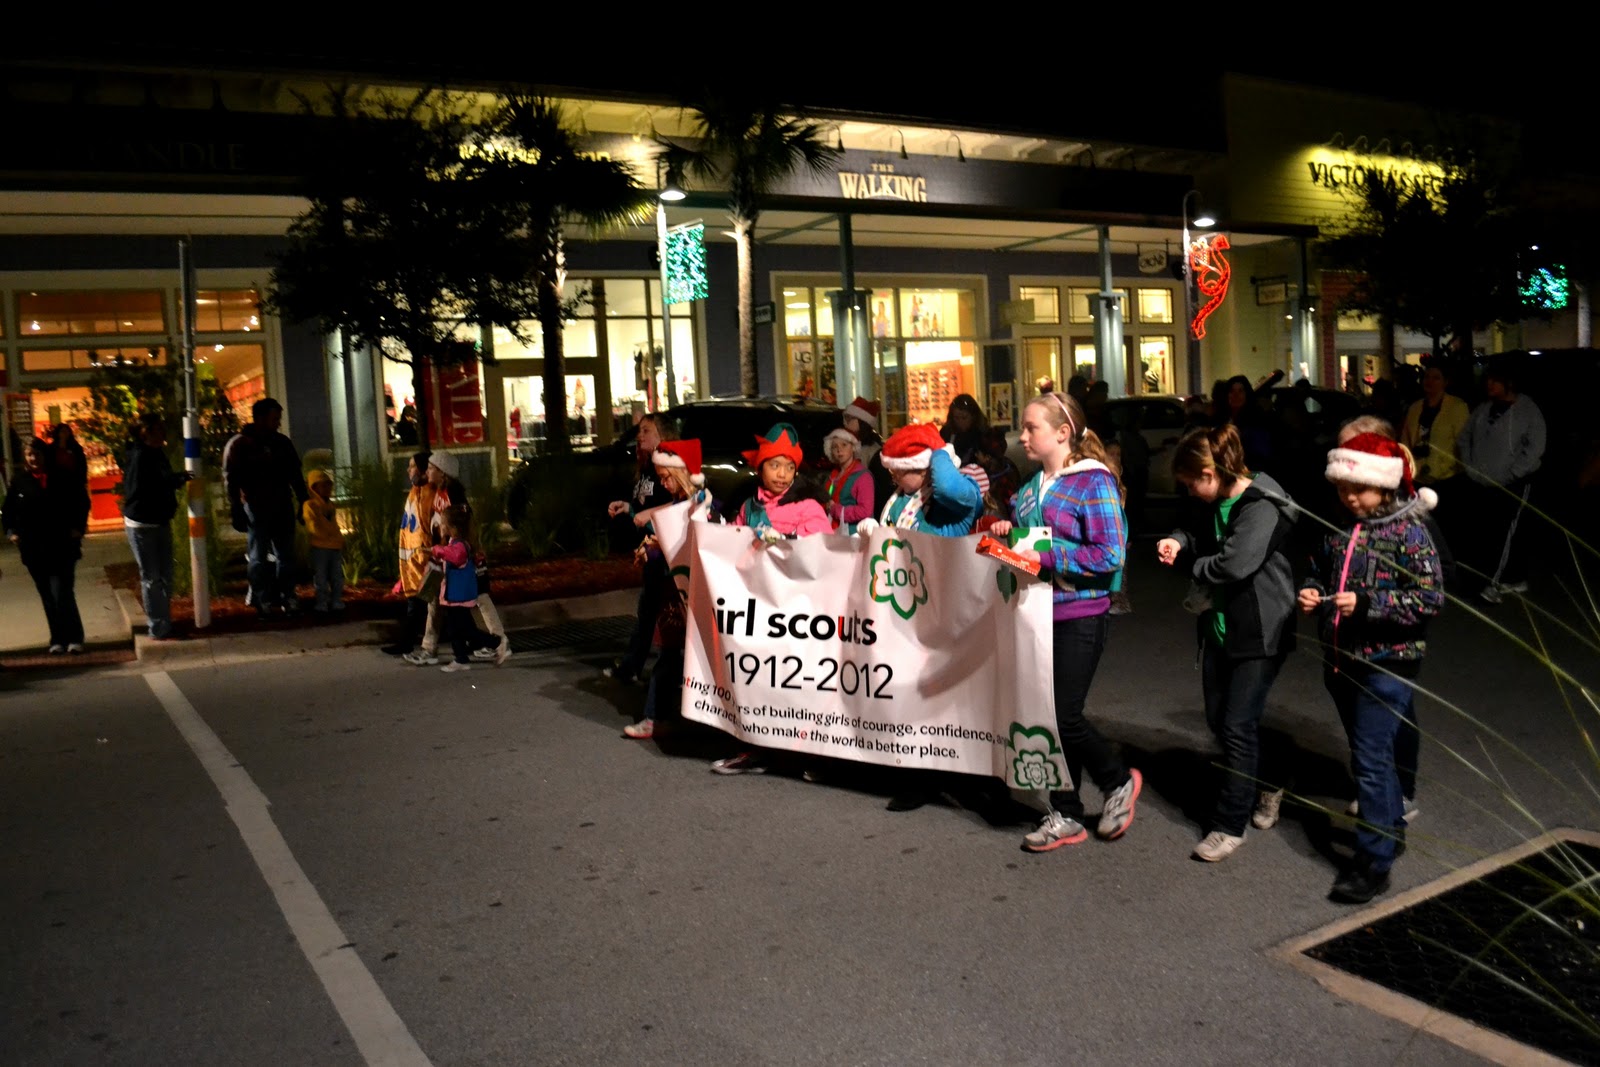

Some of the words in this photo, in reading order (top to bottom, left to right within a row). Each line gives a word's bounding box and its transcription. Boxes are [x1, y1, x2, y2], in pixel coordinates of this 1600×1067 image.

[88, 140, 247, 170] ANDLE
[871, 163, 894, 173] THE
[838, 172, 926, 203] WALKING
[1307, 162, 1410, 196] VICTOIA'S
[445, 362, 484, 443] ALE
[883, 568, 917, 588] 100
[713, 598, 756, 636] irl
[767, 609, 877, 645] scouts
[725, 652, 893, 699] 1912-2012
[683, 677, 710, 695] ting
[713, 685, 731, 701] 100
[753, 705, 767, 716] of
[770, 706, 823, 725] building
[825, 712, 850, 726] girls
[851, 717, 861, 728] of
[863, 721, 917, 736] courage,
[920, 724, 996, 744] confidence,
[694, 700, 739, 724] charact
[742, 723, 769, 735] who
[772, 726, 808, 740] make
[810, 730, 829, 742] the
[831, 736, 865, 749] world
[866, 741, 874, 750] a
[876, 738, 917, 754] better
[919, 743, 960, 759] place.
